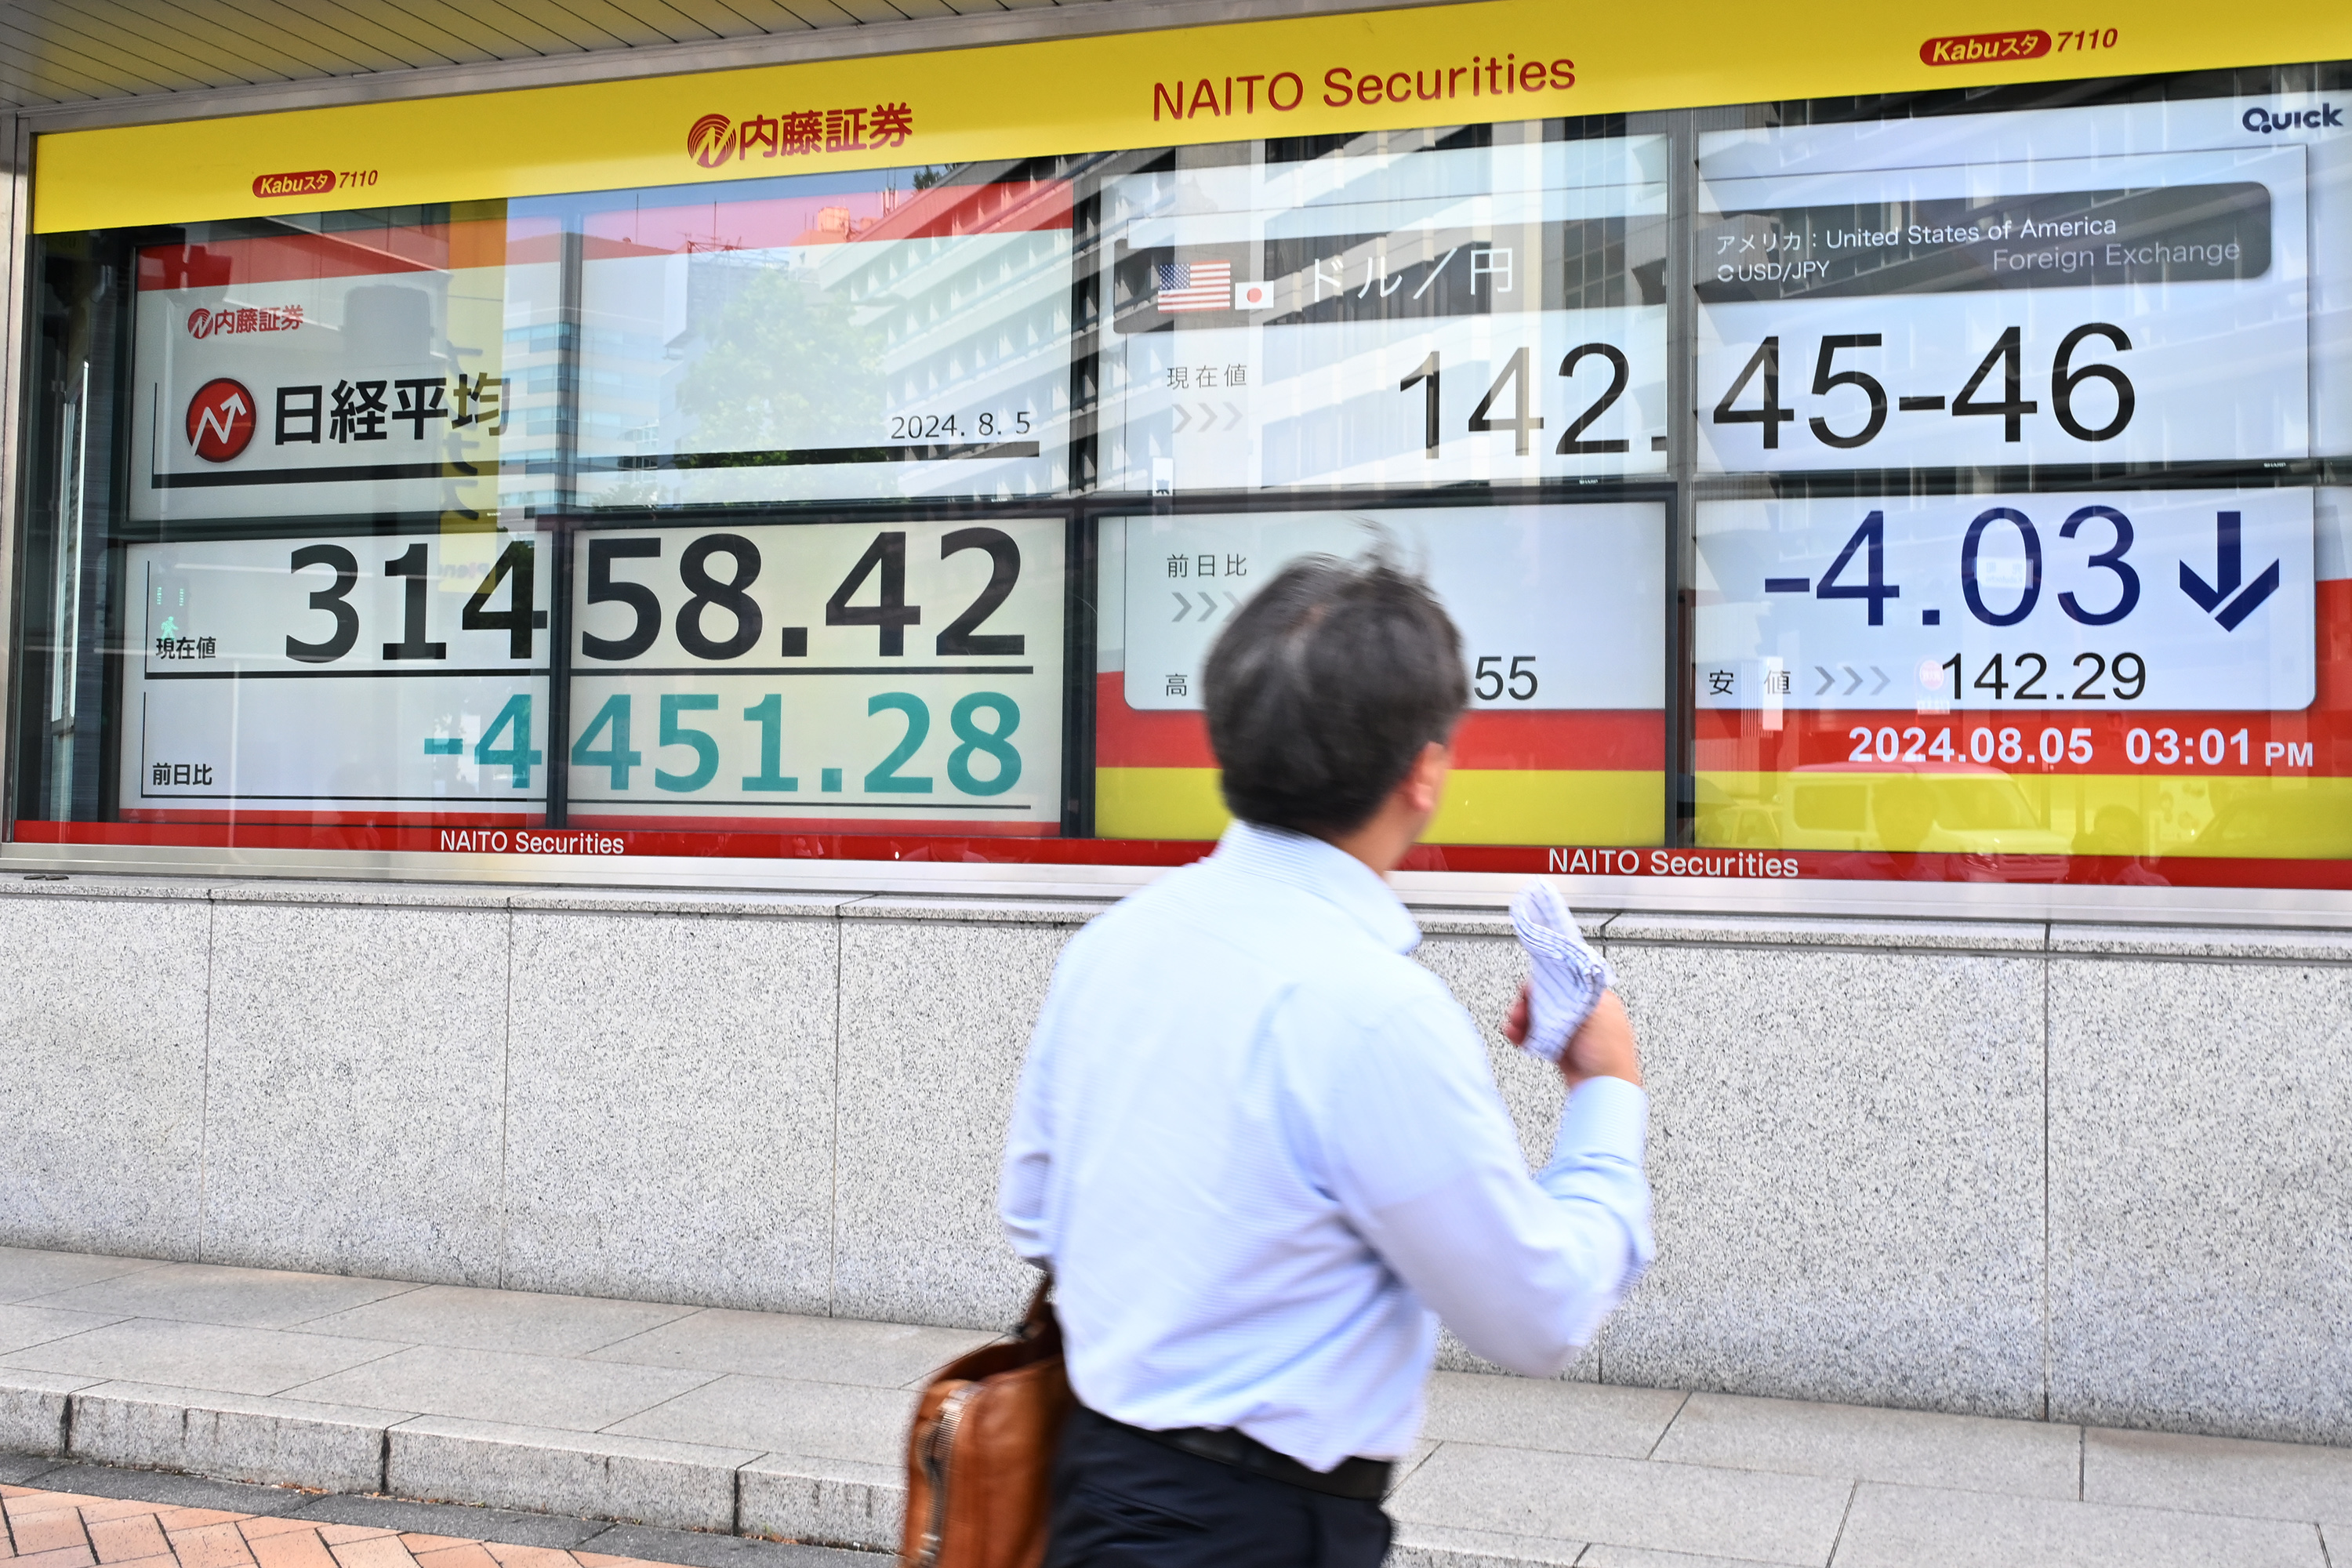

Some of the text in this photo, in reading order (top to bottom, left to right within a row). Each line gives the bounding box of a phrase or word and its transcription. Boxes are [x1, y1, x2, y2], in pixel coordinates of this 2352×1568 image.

[1933, 28, 2118, 62] Kabuスタ 7110
[1153, 53, 1576, 122] NAITO Securities
[739, 102, 913, 161] 内藤証券
[260, 169, 379, 194] Kabuスタ 7110
[1826, 228, 1899, 249] United
[1907, 223, 1979, 244] States
[1987, 220, 2012, 241] of
[2020, 216, 2117, 239] America
[1993, 247, 2094, 273] Foreign
[2106, 241, 2241, 267] Exchange
[214, 305, 304, 335] 内藤証券
[1167, 364, 1248, 390] 現在値
[274, 372, 512, 446] 日経平均
[1167, 554, 1248, 578] 前日比
[1765, 505, 2141, 626] -4.03
[155, 636, 217, 659] 現在値
[1942, 652, 2146, 700] 142.29
[1848, 726, 2314, 767] 2024.08.05 03:01 PM
[152, 762, 212, 786] 前日比
[440, 829, 625, 855] NAITO Securities
[1548, 848, 1799, 878] NAITO Securities
